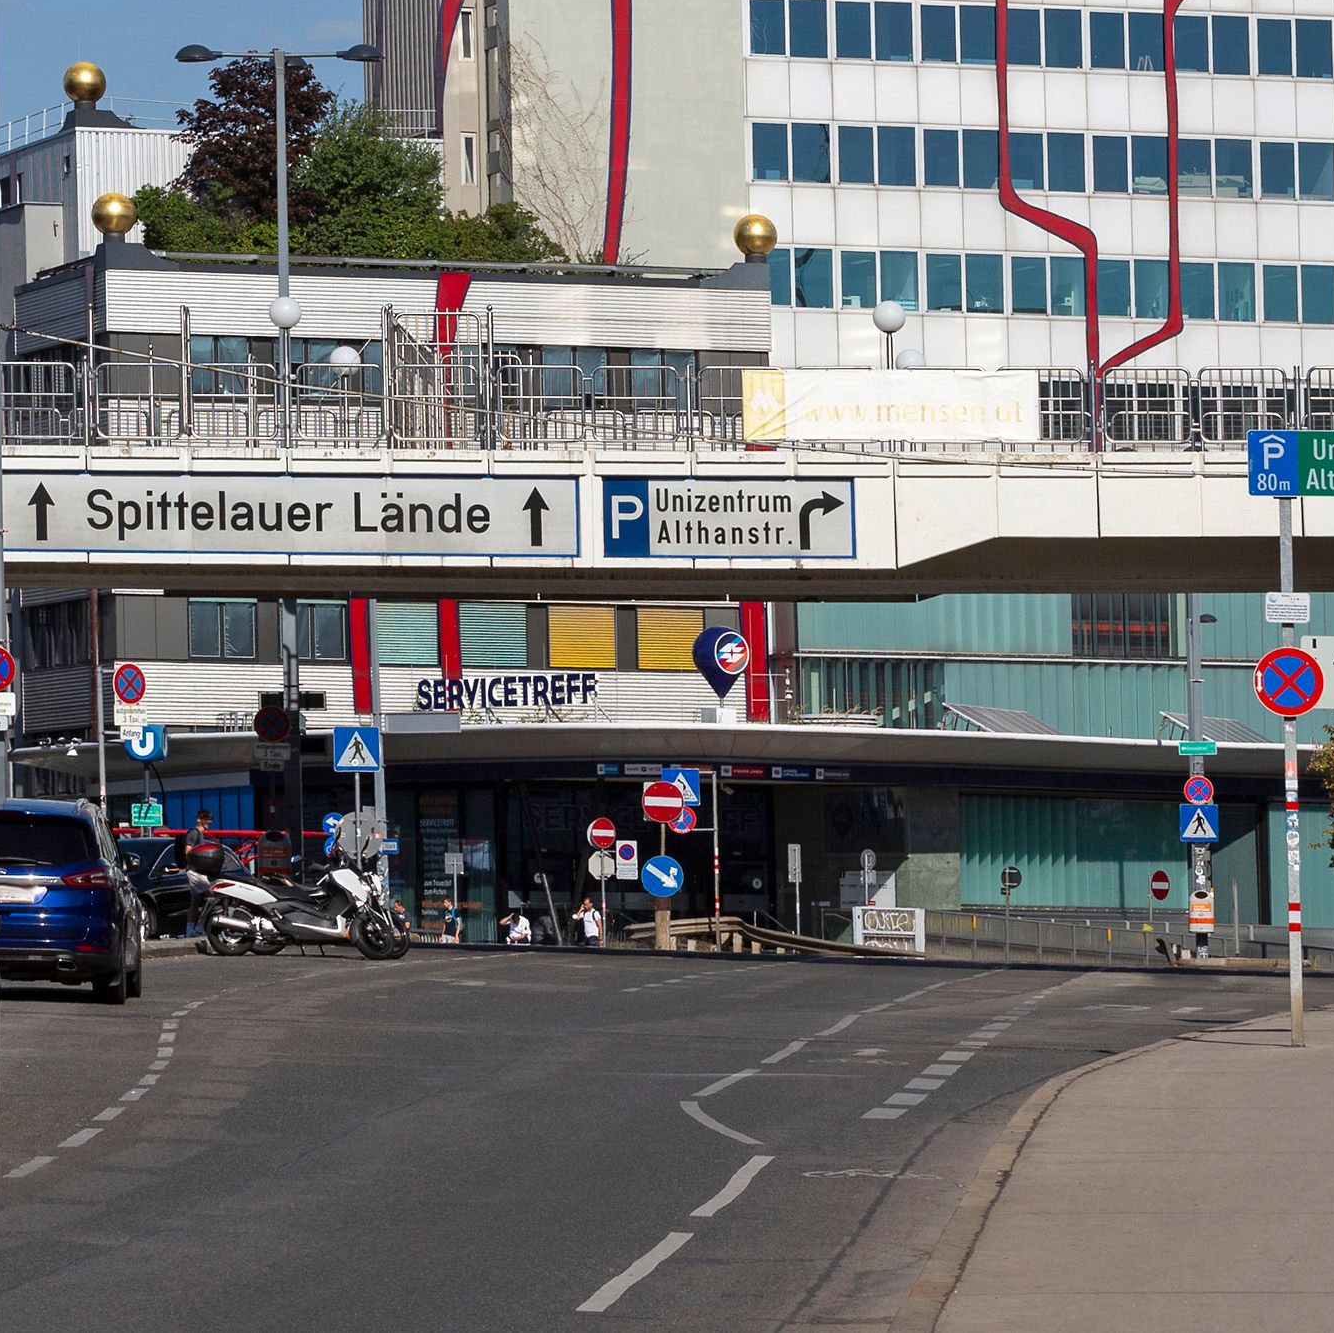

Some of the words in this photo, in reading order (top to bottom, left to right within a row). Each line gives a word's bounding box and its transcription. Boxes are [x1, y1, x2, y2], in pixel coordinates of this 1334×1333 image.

[86, 488, 334, 541] Spittelauer
[353, 490, 490, 534] Lände
[611, 495, 644, 539] P
[655, 488, 792, 513] Unizentrum
[657, 519, 794, 545] Althanstr.
[417, 673, 597, 711] SERVICETREFF
